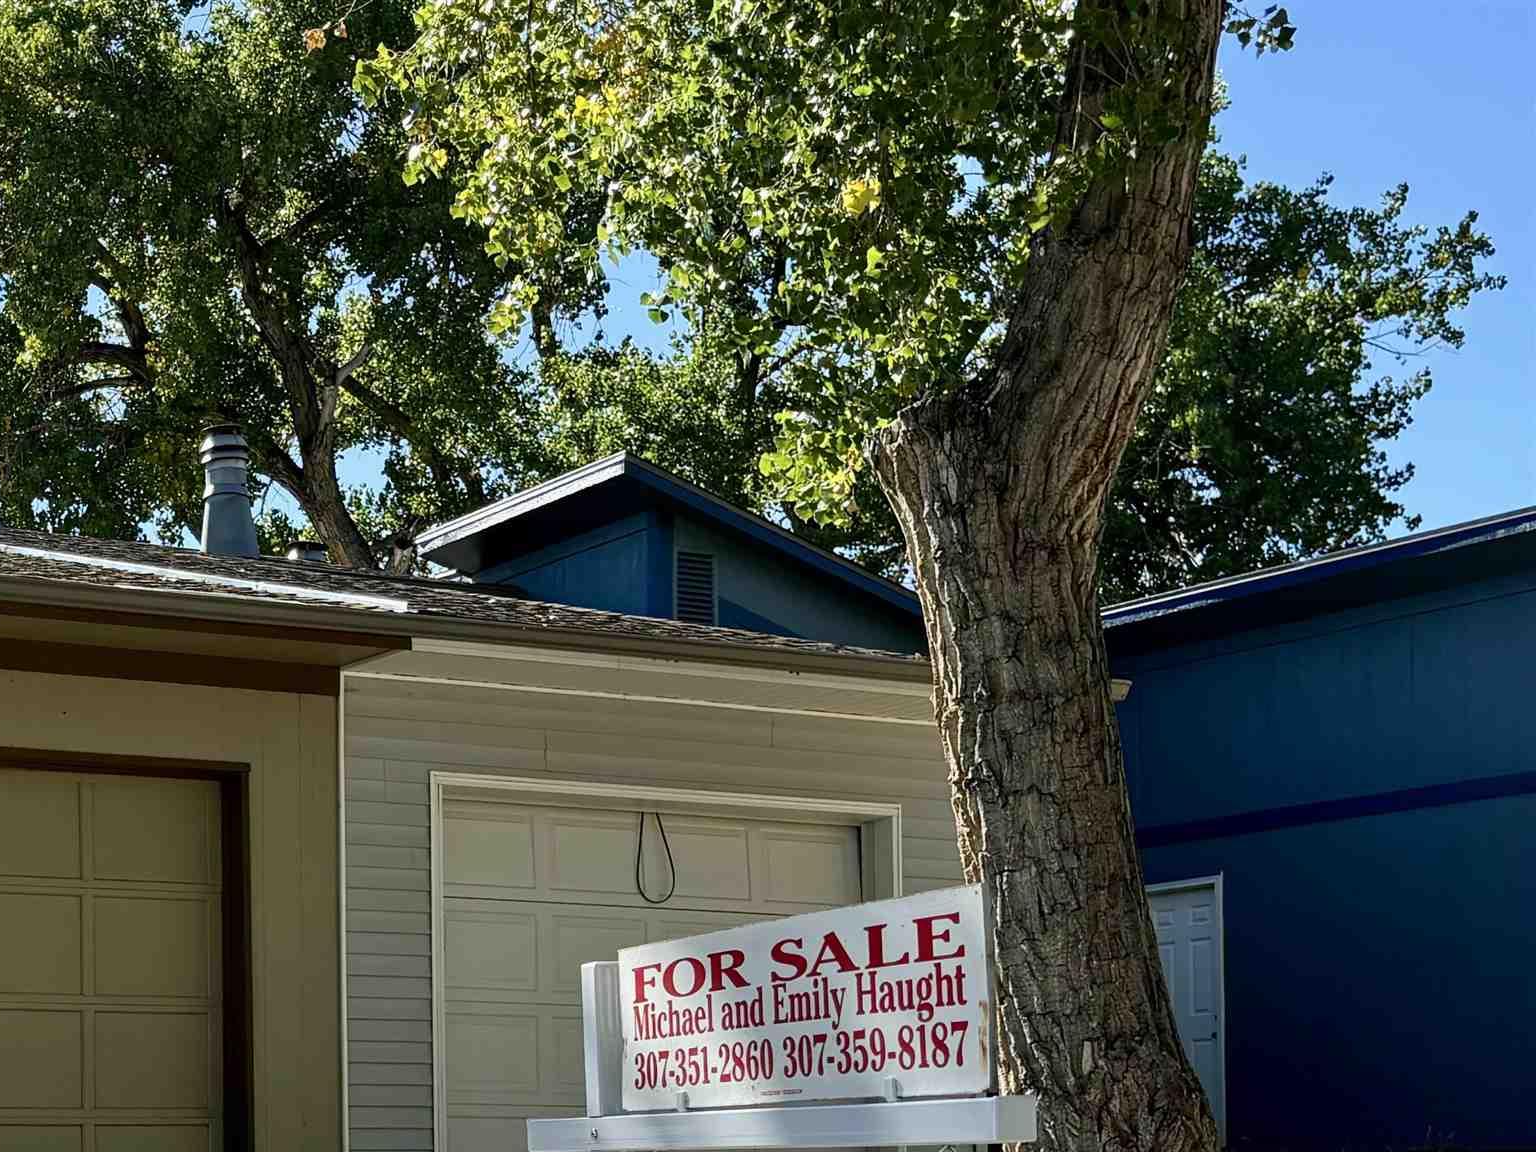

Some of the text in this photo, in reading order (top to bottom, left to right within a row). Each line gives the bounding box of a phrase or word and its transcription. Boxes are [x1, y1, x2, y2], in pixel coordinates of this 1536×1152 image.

[631, 912, 966, 1004] FOR SALE
[632, 961, 967, 1042] Michael and Emily Haught
[633, 1021, 969, 1090] 307-351-2860 307-359-8187
